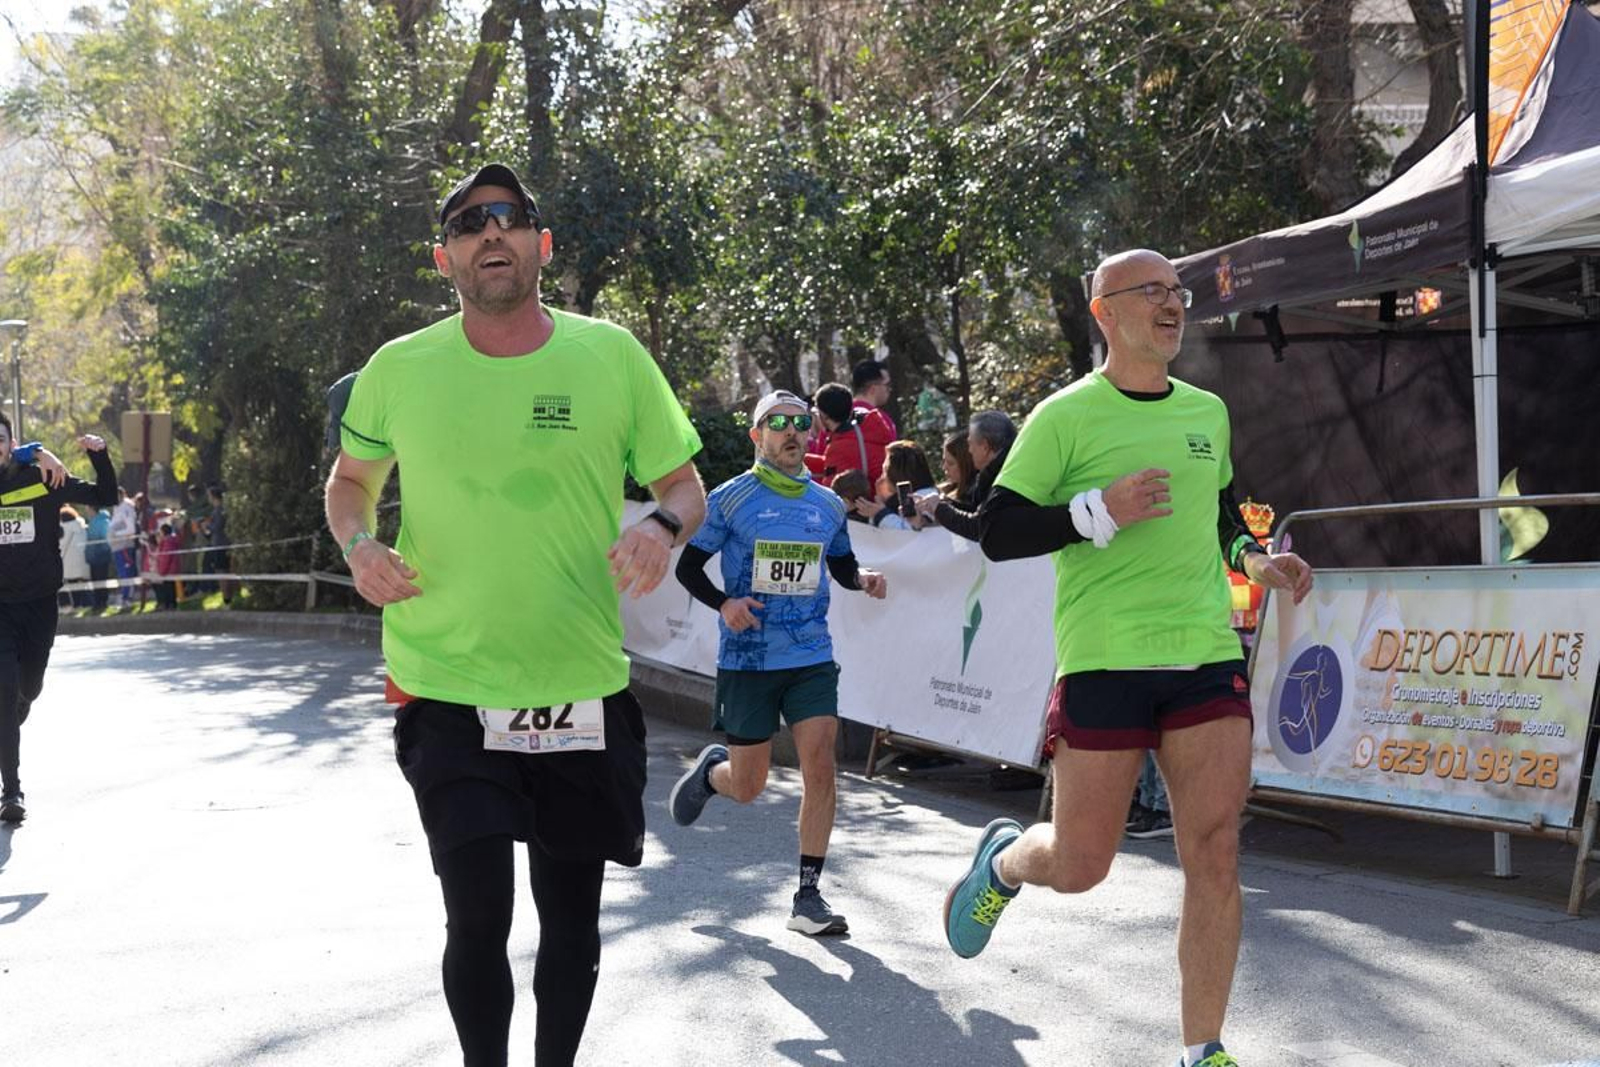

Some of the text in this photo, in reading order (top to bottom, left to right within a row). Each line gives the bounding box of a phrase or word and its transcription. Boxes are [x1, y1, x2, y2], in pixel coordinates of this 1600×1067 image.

[1396, 220, 1428, 239] Municipal
[1428, 218, 1439, 231] de
[1364, 244, 1393, 260] Deportes
[770, 560, 806, 583] 847
[1369, 628, 1570, 681] DEPORTIME
[1392, 683, 1459, 708] Cronometraje
[1468, 687, 1543, 712] Inscripciones
[508, 702, 575, 732] 282
[1521, 718, 1567, 738] deportiva
[1377, 738, 1561, 791] 623 01 98 28
